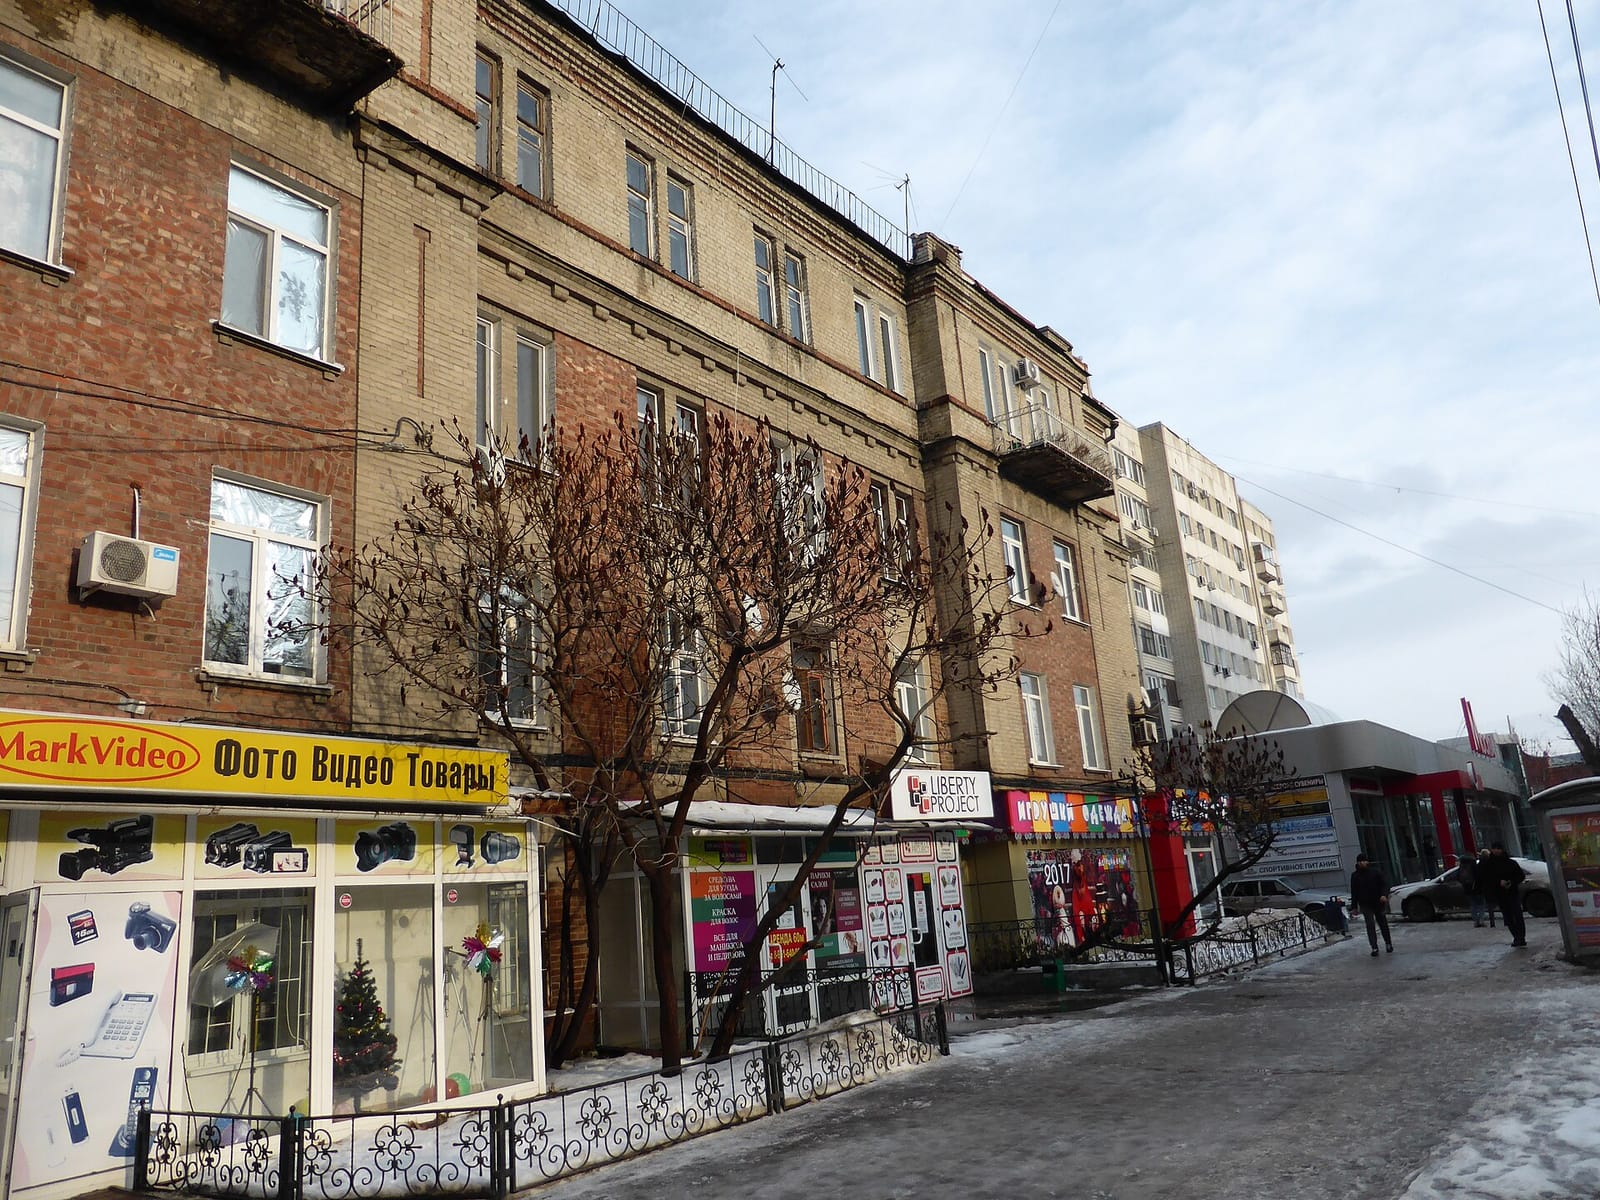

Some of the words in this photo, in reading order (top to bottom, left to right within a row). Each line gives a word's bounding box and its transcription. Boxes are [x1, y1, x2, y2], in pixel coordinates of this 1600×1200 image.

[214, 738, 297, 781] Фото
[312, 745, 394, 788] Видео
[407, 752, 495, 795] Товары
[930, 775, 976, 795] LIBERTY
[931, 795, 979, 813] PROJECT
[1017, 800, 1074, 823] ИГРУШКИ
[1081, 803, 1129, 826] ОДЕЖДА
[1044, 863, 1070, 885] 2017
[1259, 864, 1304, 873] СПОРТИВНОЕ
[1304, 859, 1337, 870] ПИТАНИЕ
[712, 907, 737, 917] КРАСКА
